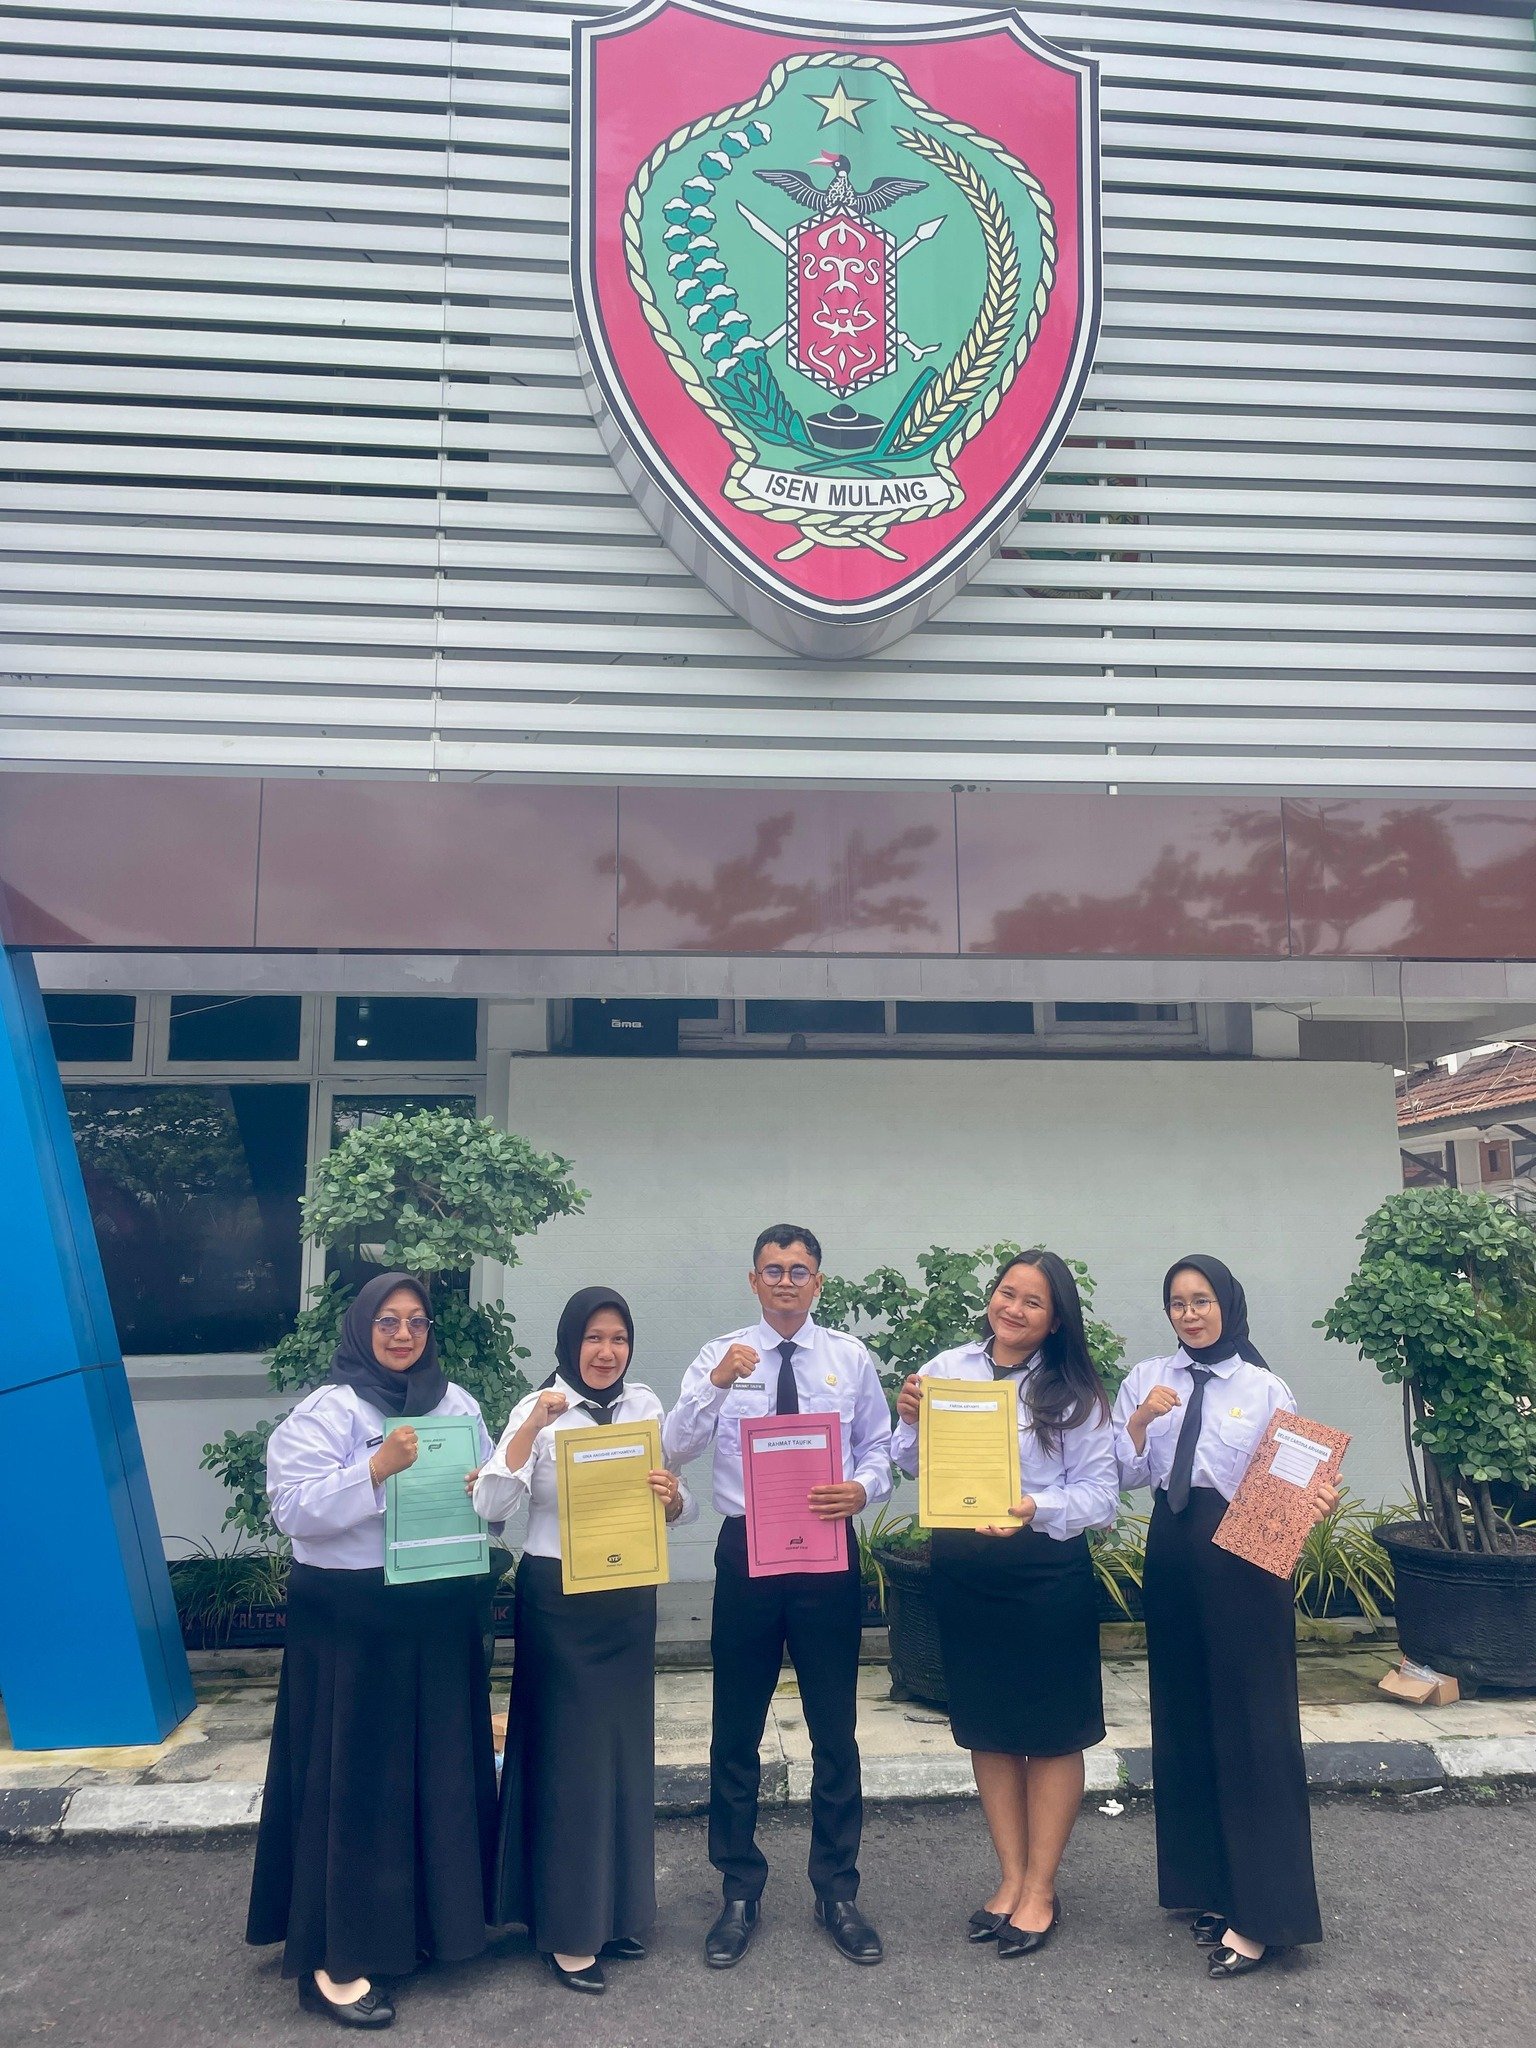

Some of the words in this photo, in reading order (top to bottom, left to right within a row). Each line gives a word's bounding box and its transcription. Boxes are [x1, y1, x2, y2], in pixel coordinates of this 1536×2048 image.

[764, 474, 819, 503] ISEN
[828, 481, 928, 507] MULANG
[767, 1440, 791, 1448] RAHMAT
[232, 1612, 286, 1629] KALTEN
